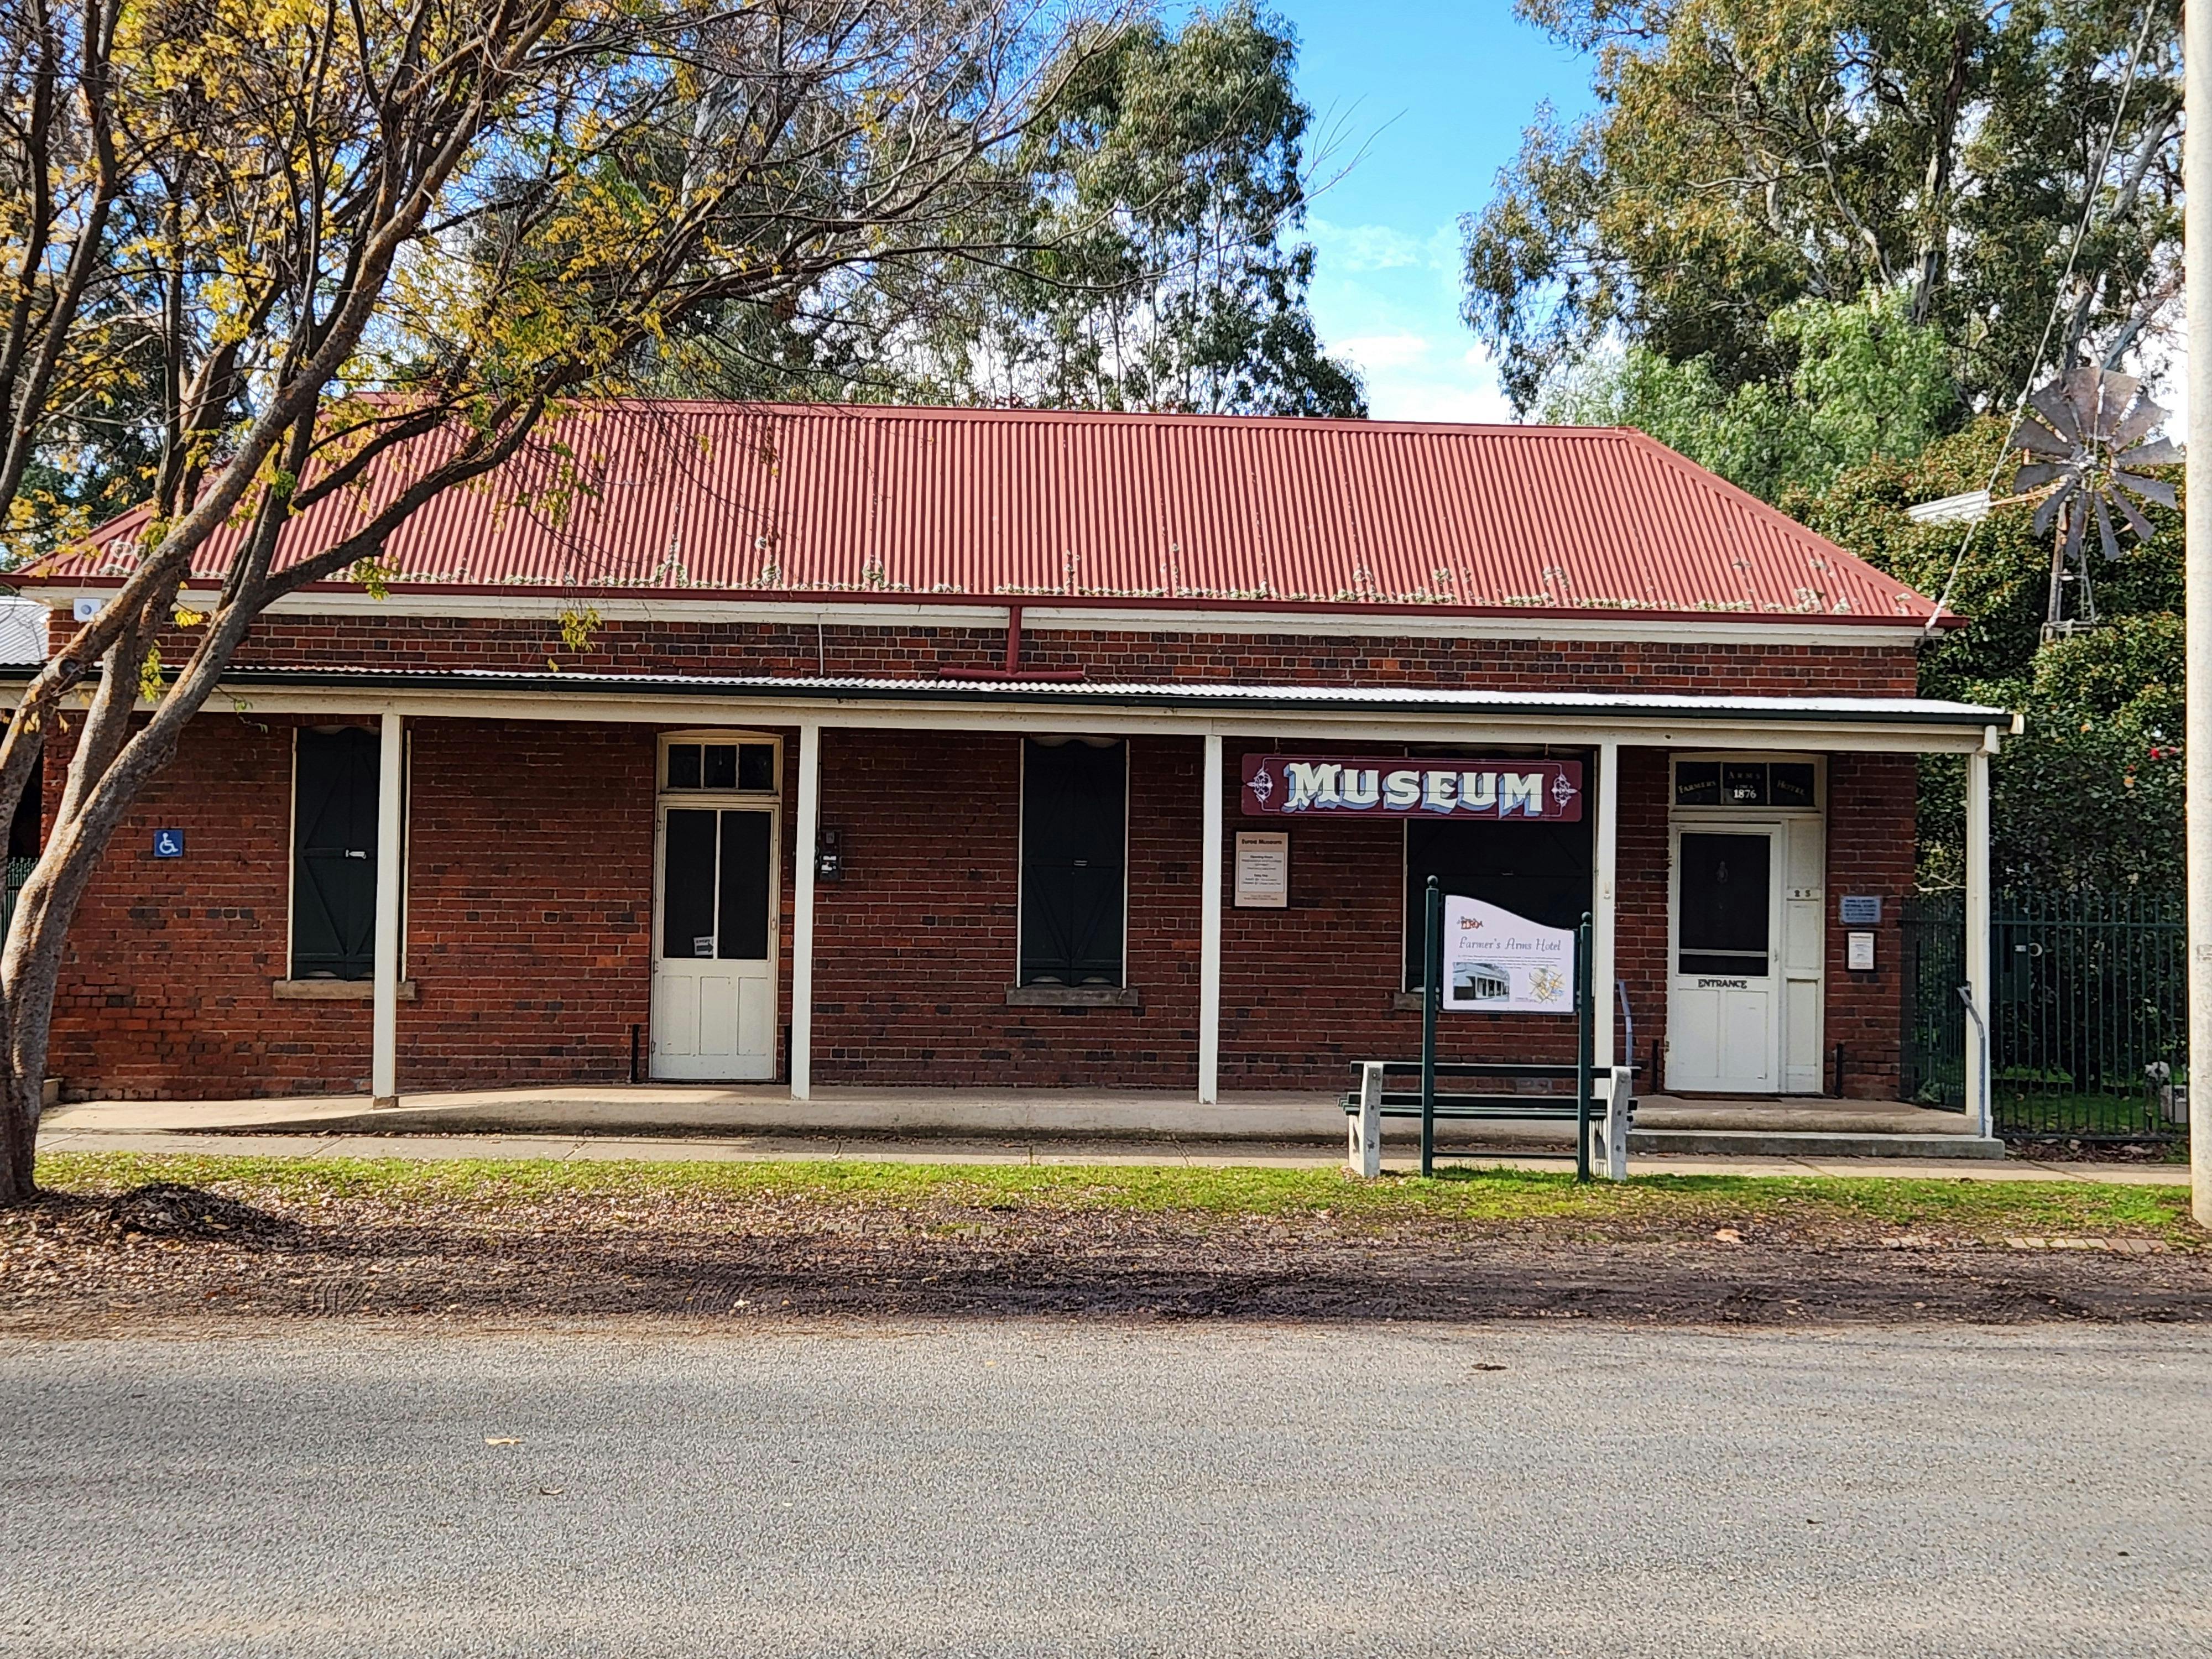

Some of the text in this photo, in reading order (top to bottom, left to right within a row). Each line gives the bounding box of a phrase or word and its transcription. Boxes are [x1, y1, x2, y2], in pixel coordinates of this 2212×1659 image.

[1282, 761, 1544, 819] MUSEUM
[1734, 789, 1757, 799] 1876
[1459, 936, 1561, 952] Farmer's Arms Hotel
[1698, 978, 1747, 989] ENTRANCE
